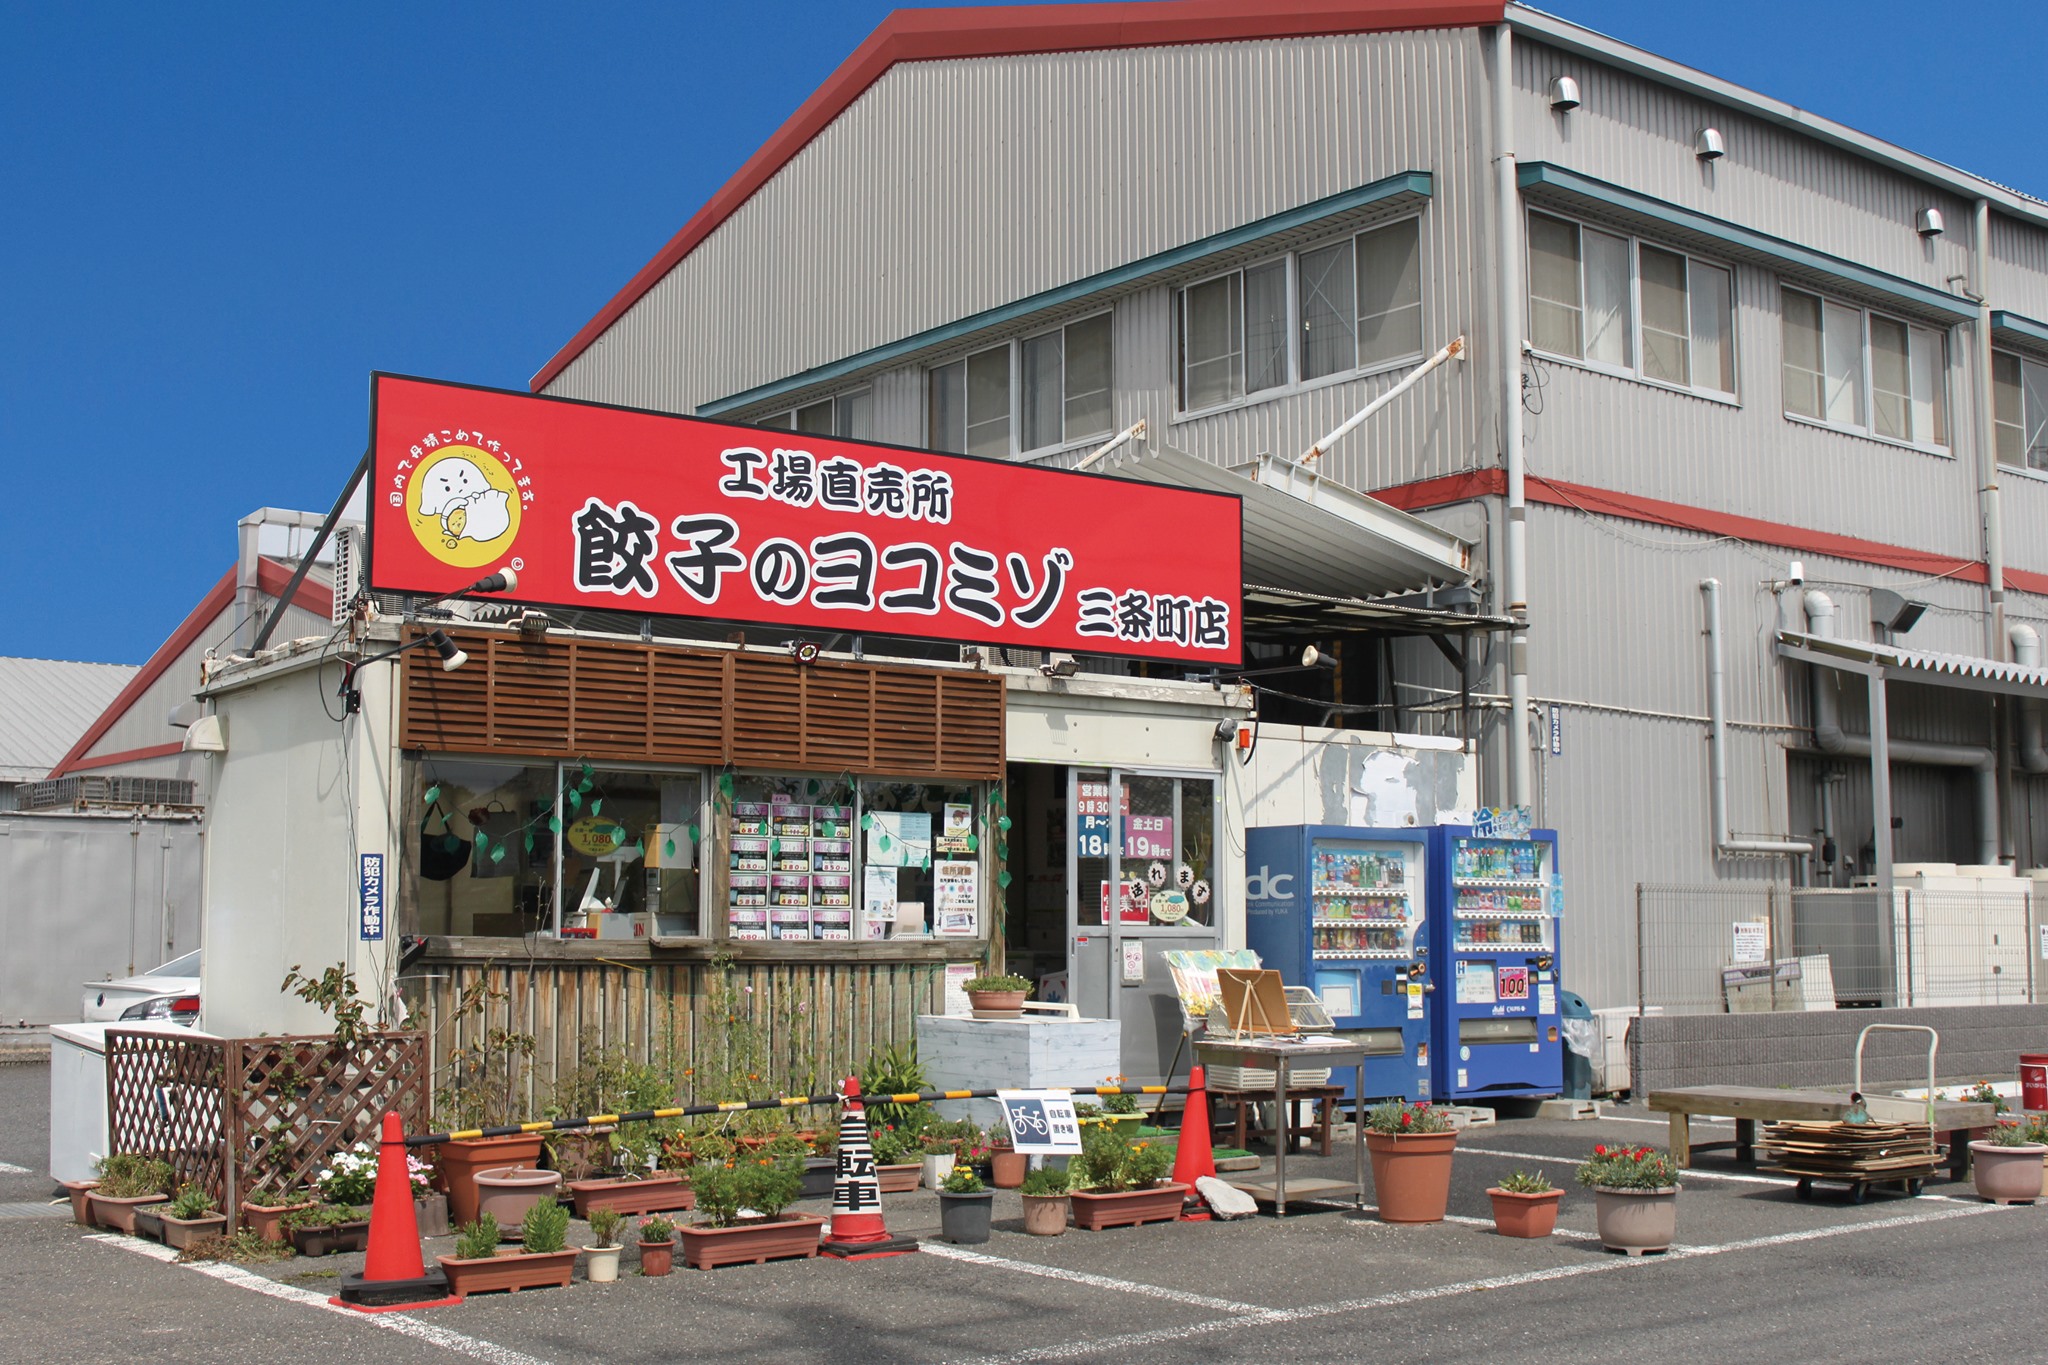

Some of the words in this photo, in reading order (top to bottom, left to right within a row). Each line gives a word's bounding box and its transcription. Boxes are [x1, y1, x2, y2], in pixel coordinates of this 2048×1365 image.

[389, 429, 535, 511] 国内で丹精こめて作ってます。
[722, 450, 952, 523] 工場直売所
[574, 500, 1073, 626] 餃子のヨコミゾ
[1078, 588, 1229, 648] 三条町店
[1127, 836, 1172, 857] 19時まで
[1133, 817, 1164, 831] 金土日
[363, 857, 381, 936] 防犯カメラ作動中
[1500, 978, 1524, 994] 100
[1049, 1109, 1072, 1119] 自転車
[1052, 1124, 1074, 1134] 置き場
[832, 1115, 880, 1212] 自転車
